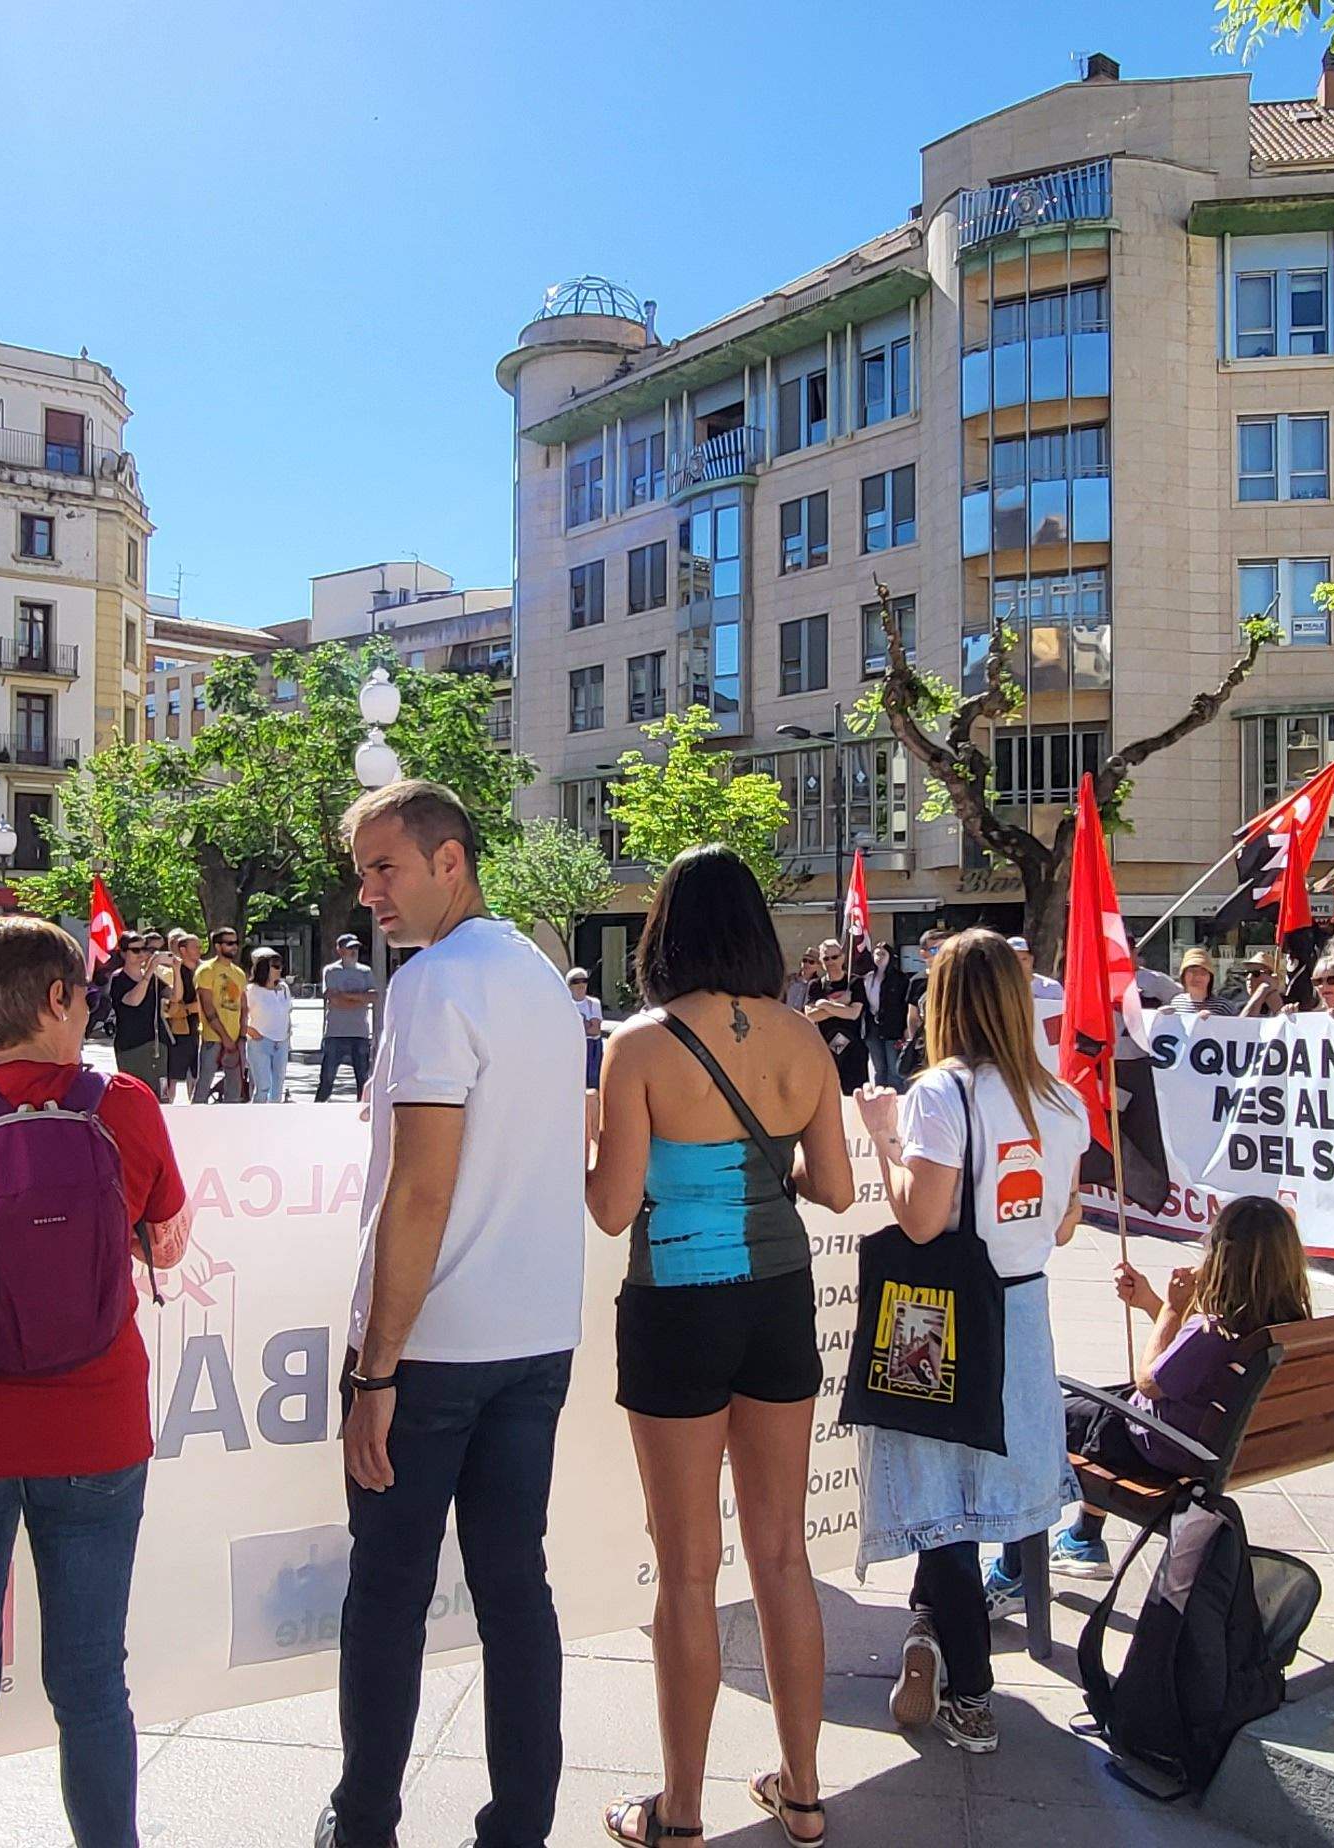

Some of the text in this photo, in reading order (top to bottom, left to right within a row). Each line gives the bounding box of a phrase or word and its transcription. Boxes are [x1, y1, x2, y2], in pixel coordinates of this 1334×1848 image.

[1151, 1034, 1180, 1070] S
[1189, 1037, 1312, 1079] QUEDA
[1212, 1085, 1287, 1126] MES
[1228, 1133, 1305, 1178] DEL
[999, 1197, 1040, 1220] CGT
